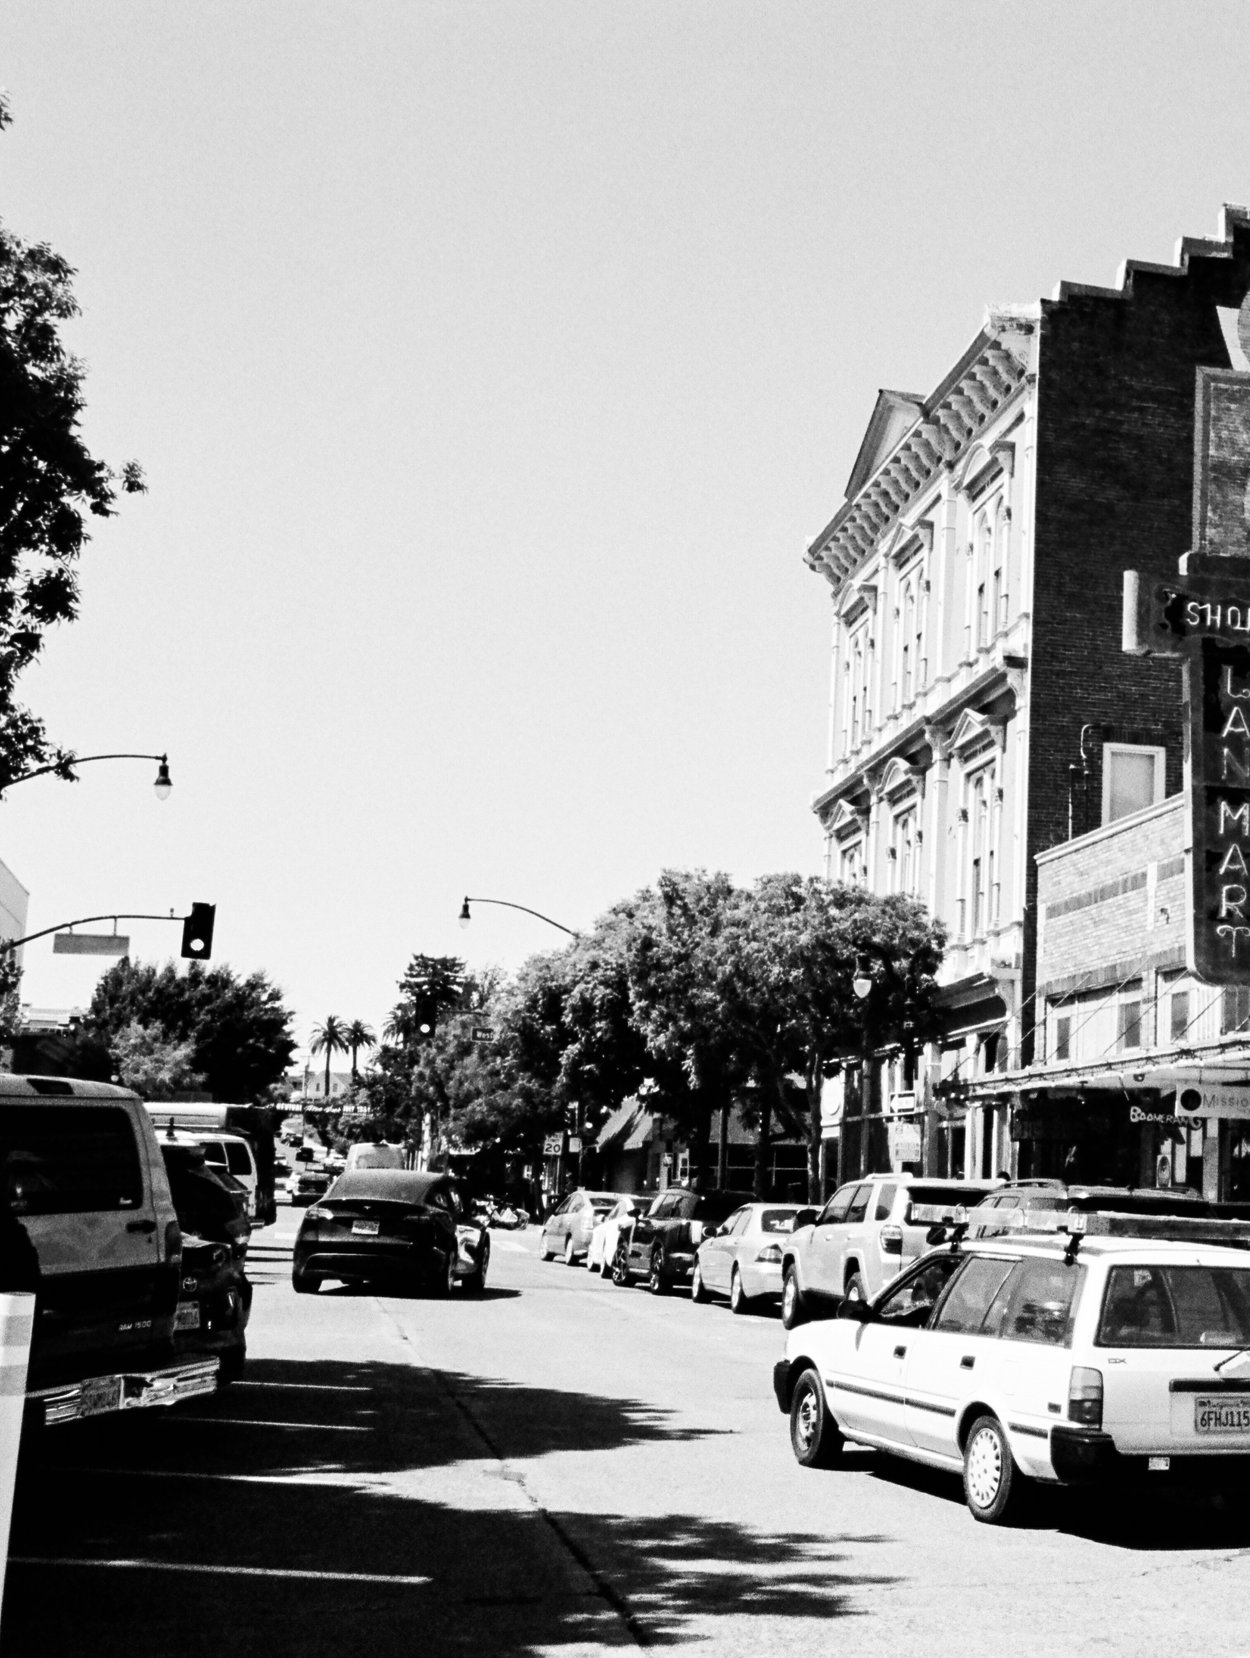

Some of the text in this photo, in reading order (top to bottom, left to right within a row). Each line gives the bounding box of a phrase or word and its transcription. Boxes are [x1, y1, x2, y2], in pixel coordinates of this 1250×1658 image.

[1130, 1105, 1203, 1131] BOOMERANG
[545, 1143, 561, 1154] 20
[1200, 1410, 1250, 1427] 6FHJ115
